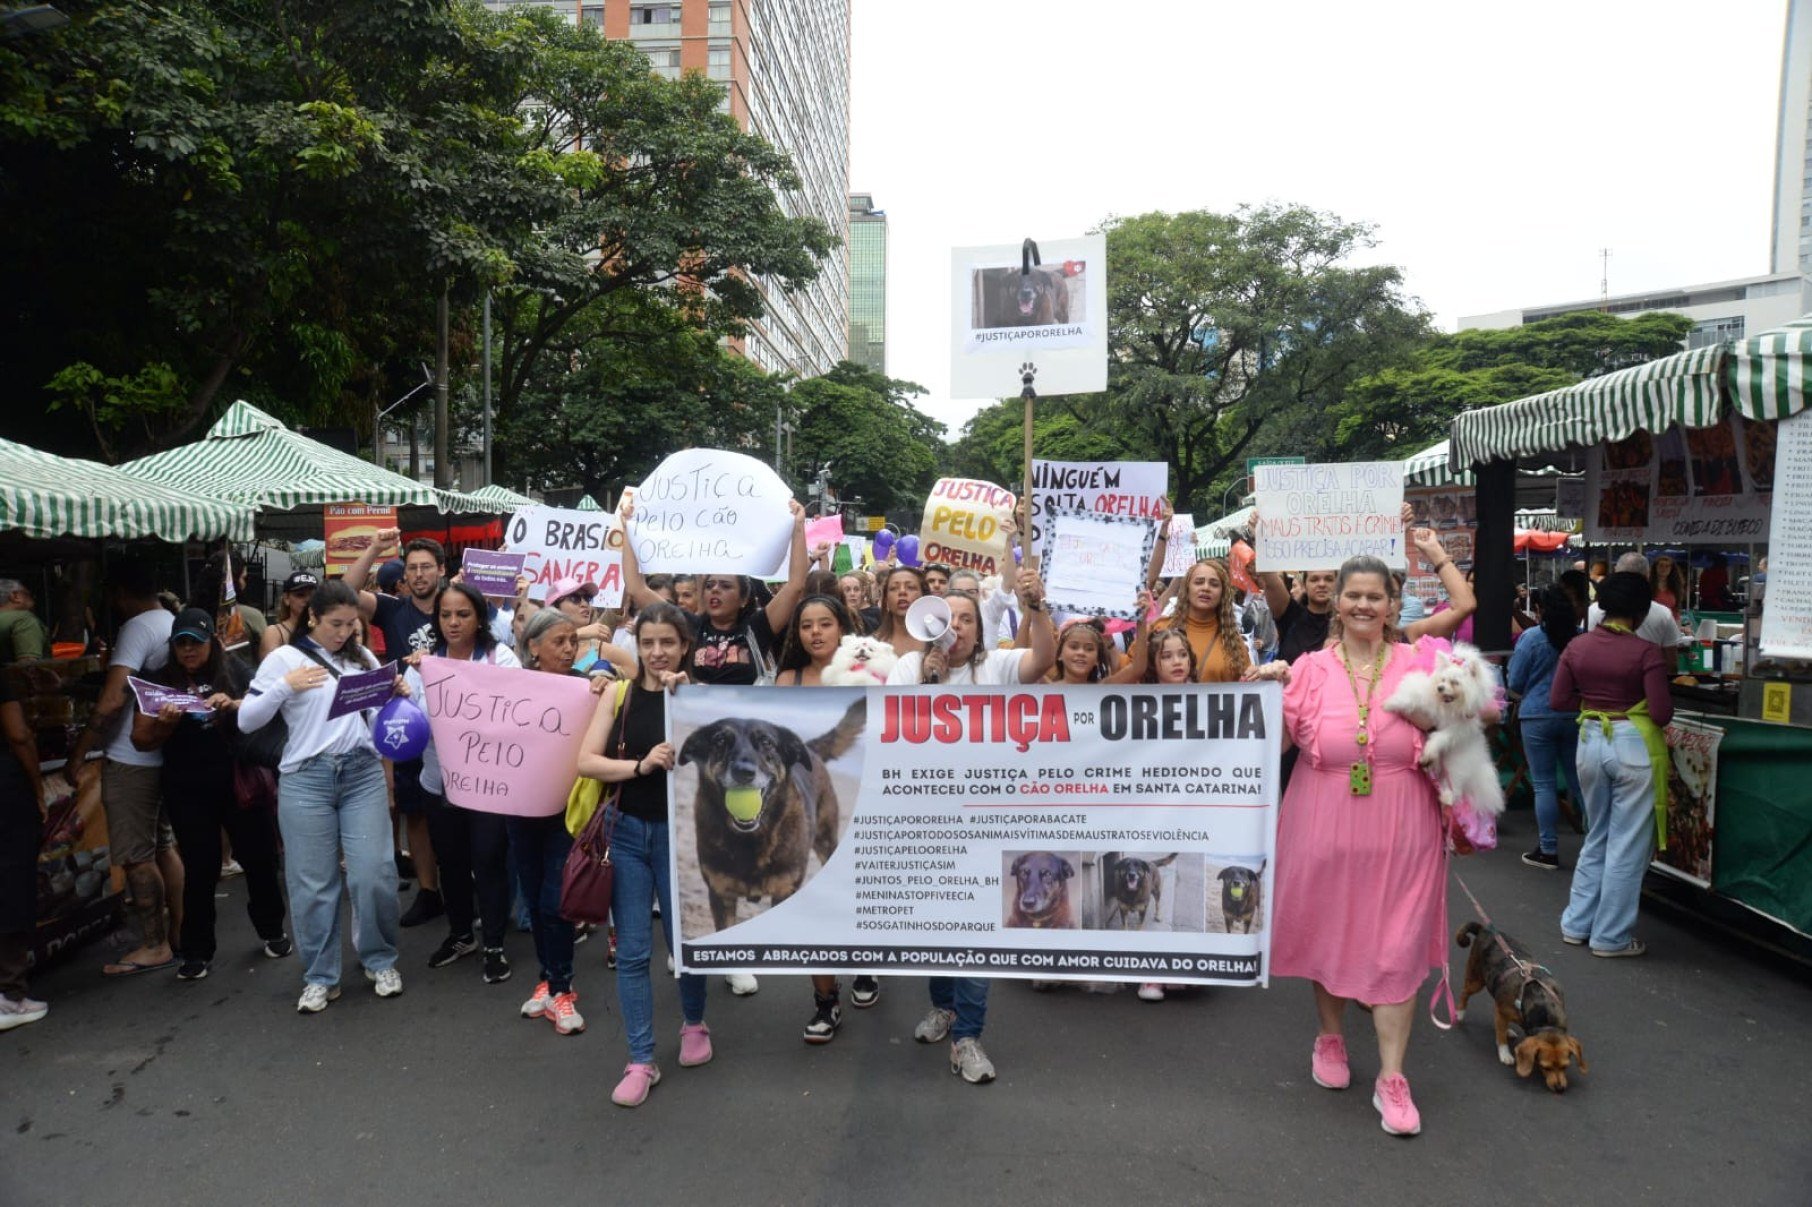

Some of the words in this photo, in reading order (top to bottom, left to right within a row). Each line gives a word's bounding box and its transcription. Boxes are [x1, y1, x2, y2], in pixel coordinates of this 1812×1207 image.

[975, 326, 1083, 342] #JUSTIÇAPORORELHA
[1352, 464, 1397, 489] POR
[1286, 489, 1377, 515] ORELHA
[931, 505, 998, 541] PELO
[513, 517, 527, 543] O
[545, 520, 609, 551] BRASI
[923, 541, 997, 576] ORELHA
[524, 552, 620, 592] SANGRA
[880, 693, 1071, 753] JUSTIÇA
[1073, 711, 1095, 725] POR
[1100, 693, 1267, 741] ORELHA
[882, 769, 901, 779] BH
[912, 769, 955, 779] EXIGE
[964, 769, 1028, 783] JUSTIÇA
[1038, 768, 1074, 779] PELO
[1084, 767, 1132, 778] CRIME
[1142, 767, 1222, 778] HEDIONDO
[1232, 767, 1262, 779] QUE
[882, 784, 965, 795] ACONTECEU
[969, 784, 1001, 795] COM
[1005, 784, 1016, 795] O
[1019, 780, 1050, 795] CÃO
[1054, 783, 1108, 794] ORELHA
[1113, 783, 1131, 794] EM
[1136, 783, 1180, 794] SANTA
[1185, 783, 1262, 795] CATARINA!
[853, 814, 964, 826] #JUSTIÇAPORORELHA
[969, 814, 1087, 826] #JUSTIÇAPORABACATE
[854, 845, 968, 857] #JUSTIÇAPELOORELHA
[855, 860, 956, 872] #VAITERJUSTIÇASIM
[855, 890, 975, 901] #MENINASTOPFIVEECIA
[856, 906, 914, 915] #METROPET
[856, 920, 996, 932] #SOSGATINHOSDOPARQUE
[693, 950, 755, 962] ESTAMOS
[762, 950, 848, 964] ABRAÇADOS
[852, 951, 883, 962] COM
[887, 951, 897, 962] A
[901, 950, 985, 967] POPULAÇÃO
[989, 953, 1017, 965] QUE
[1021, 954, 1054, 966] COM
[1058, 955, 1100, 967] AMOR
[1103, 956, 1168, 970] CUIDAVA
[1172, 958, 1193, 970] DO
[1197, 959, 1258, 973] ORELHA!
